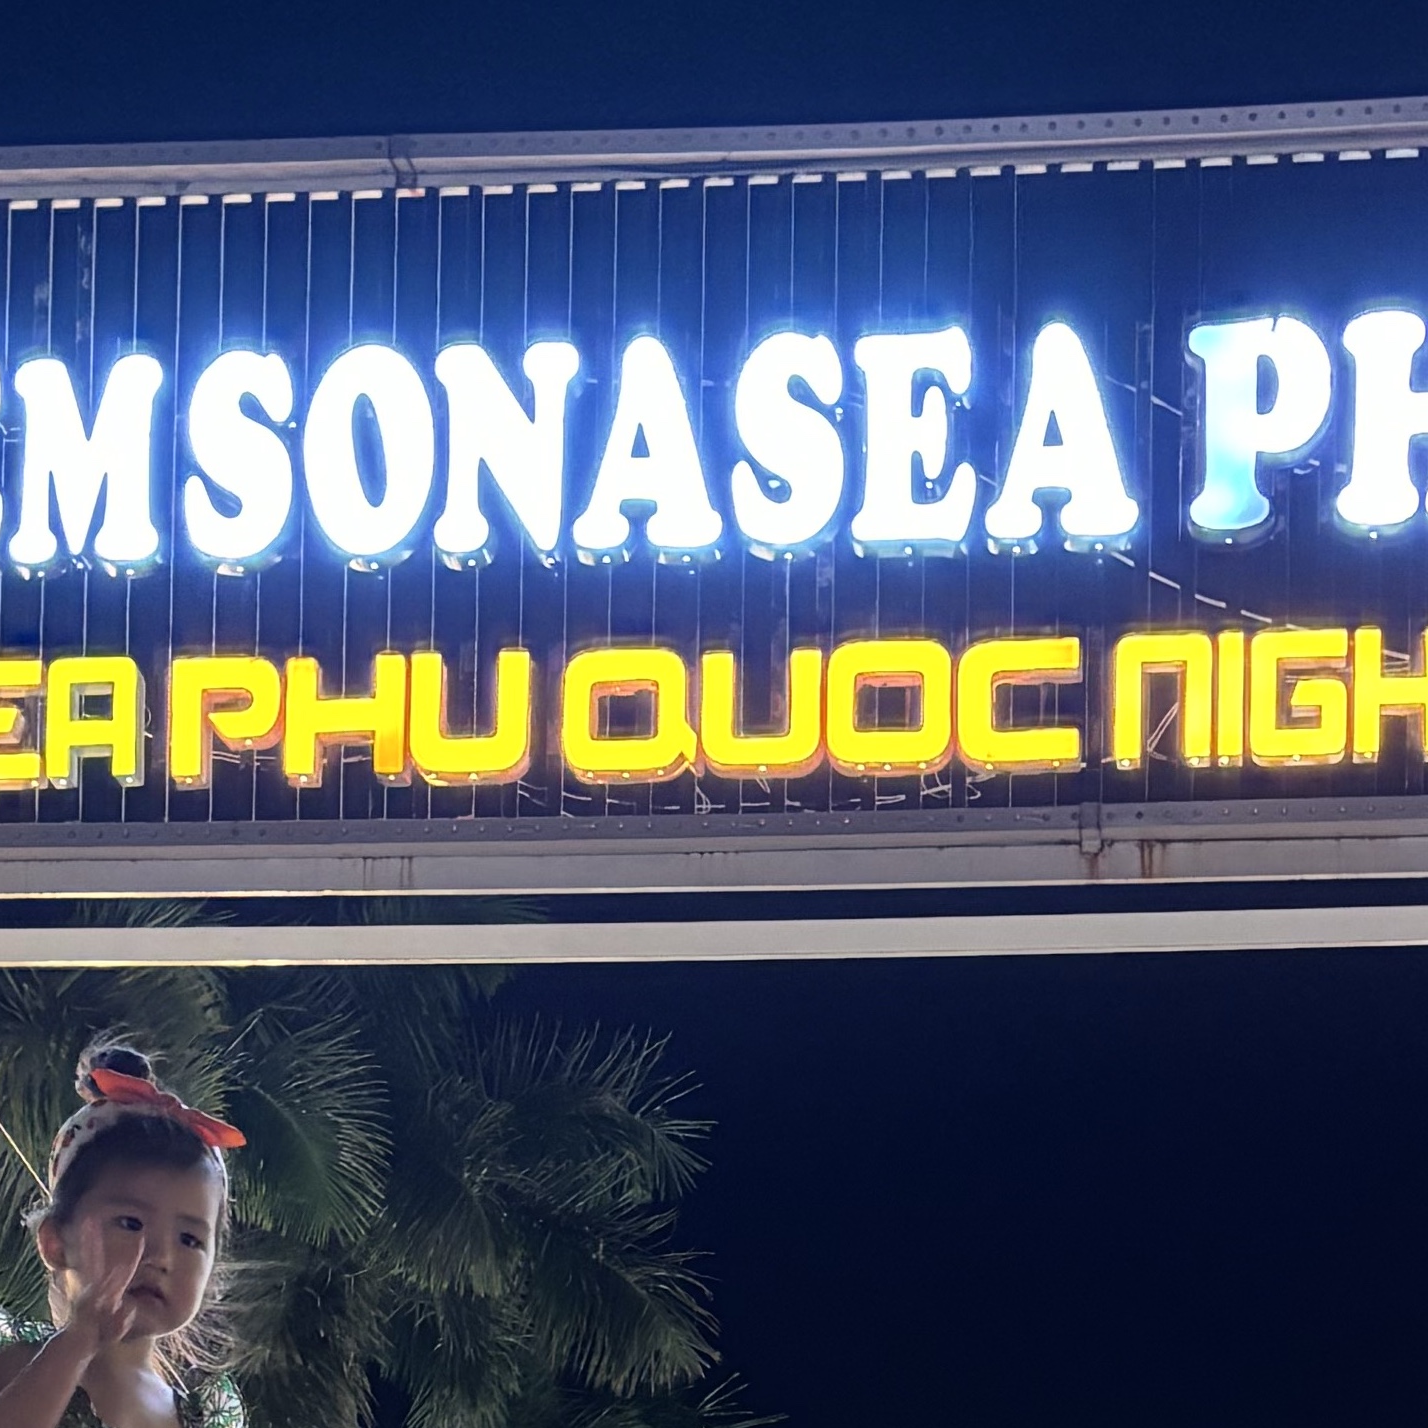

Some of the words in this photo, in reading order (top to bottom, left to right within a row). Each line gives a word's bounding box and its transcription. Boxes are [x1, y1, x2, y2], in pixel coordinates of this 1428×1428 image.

[180, 319, 1142, 566] SONASEA
[168, 650, 535, 786] PHU
[559, 635, 1084, 783] QUOC
